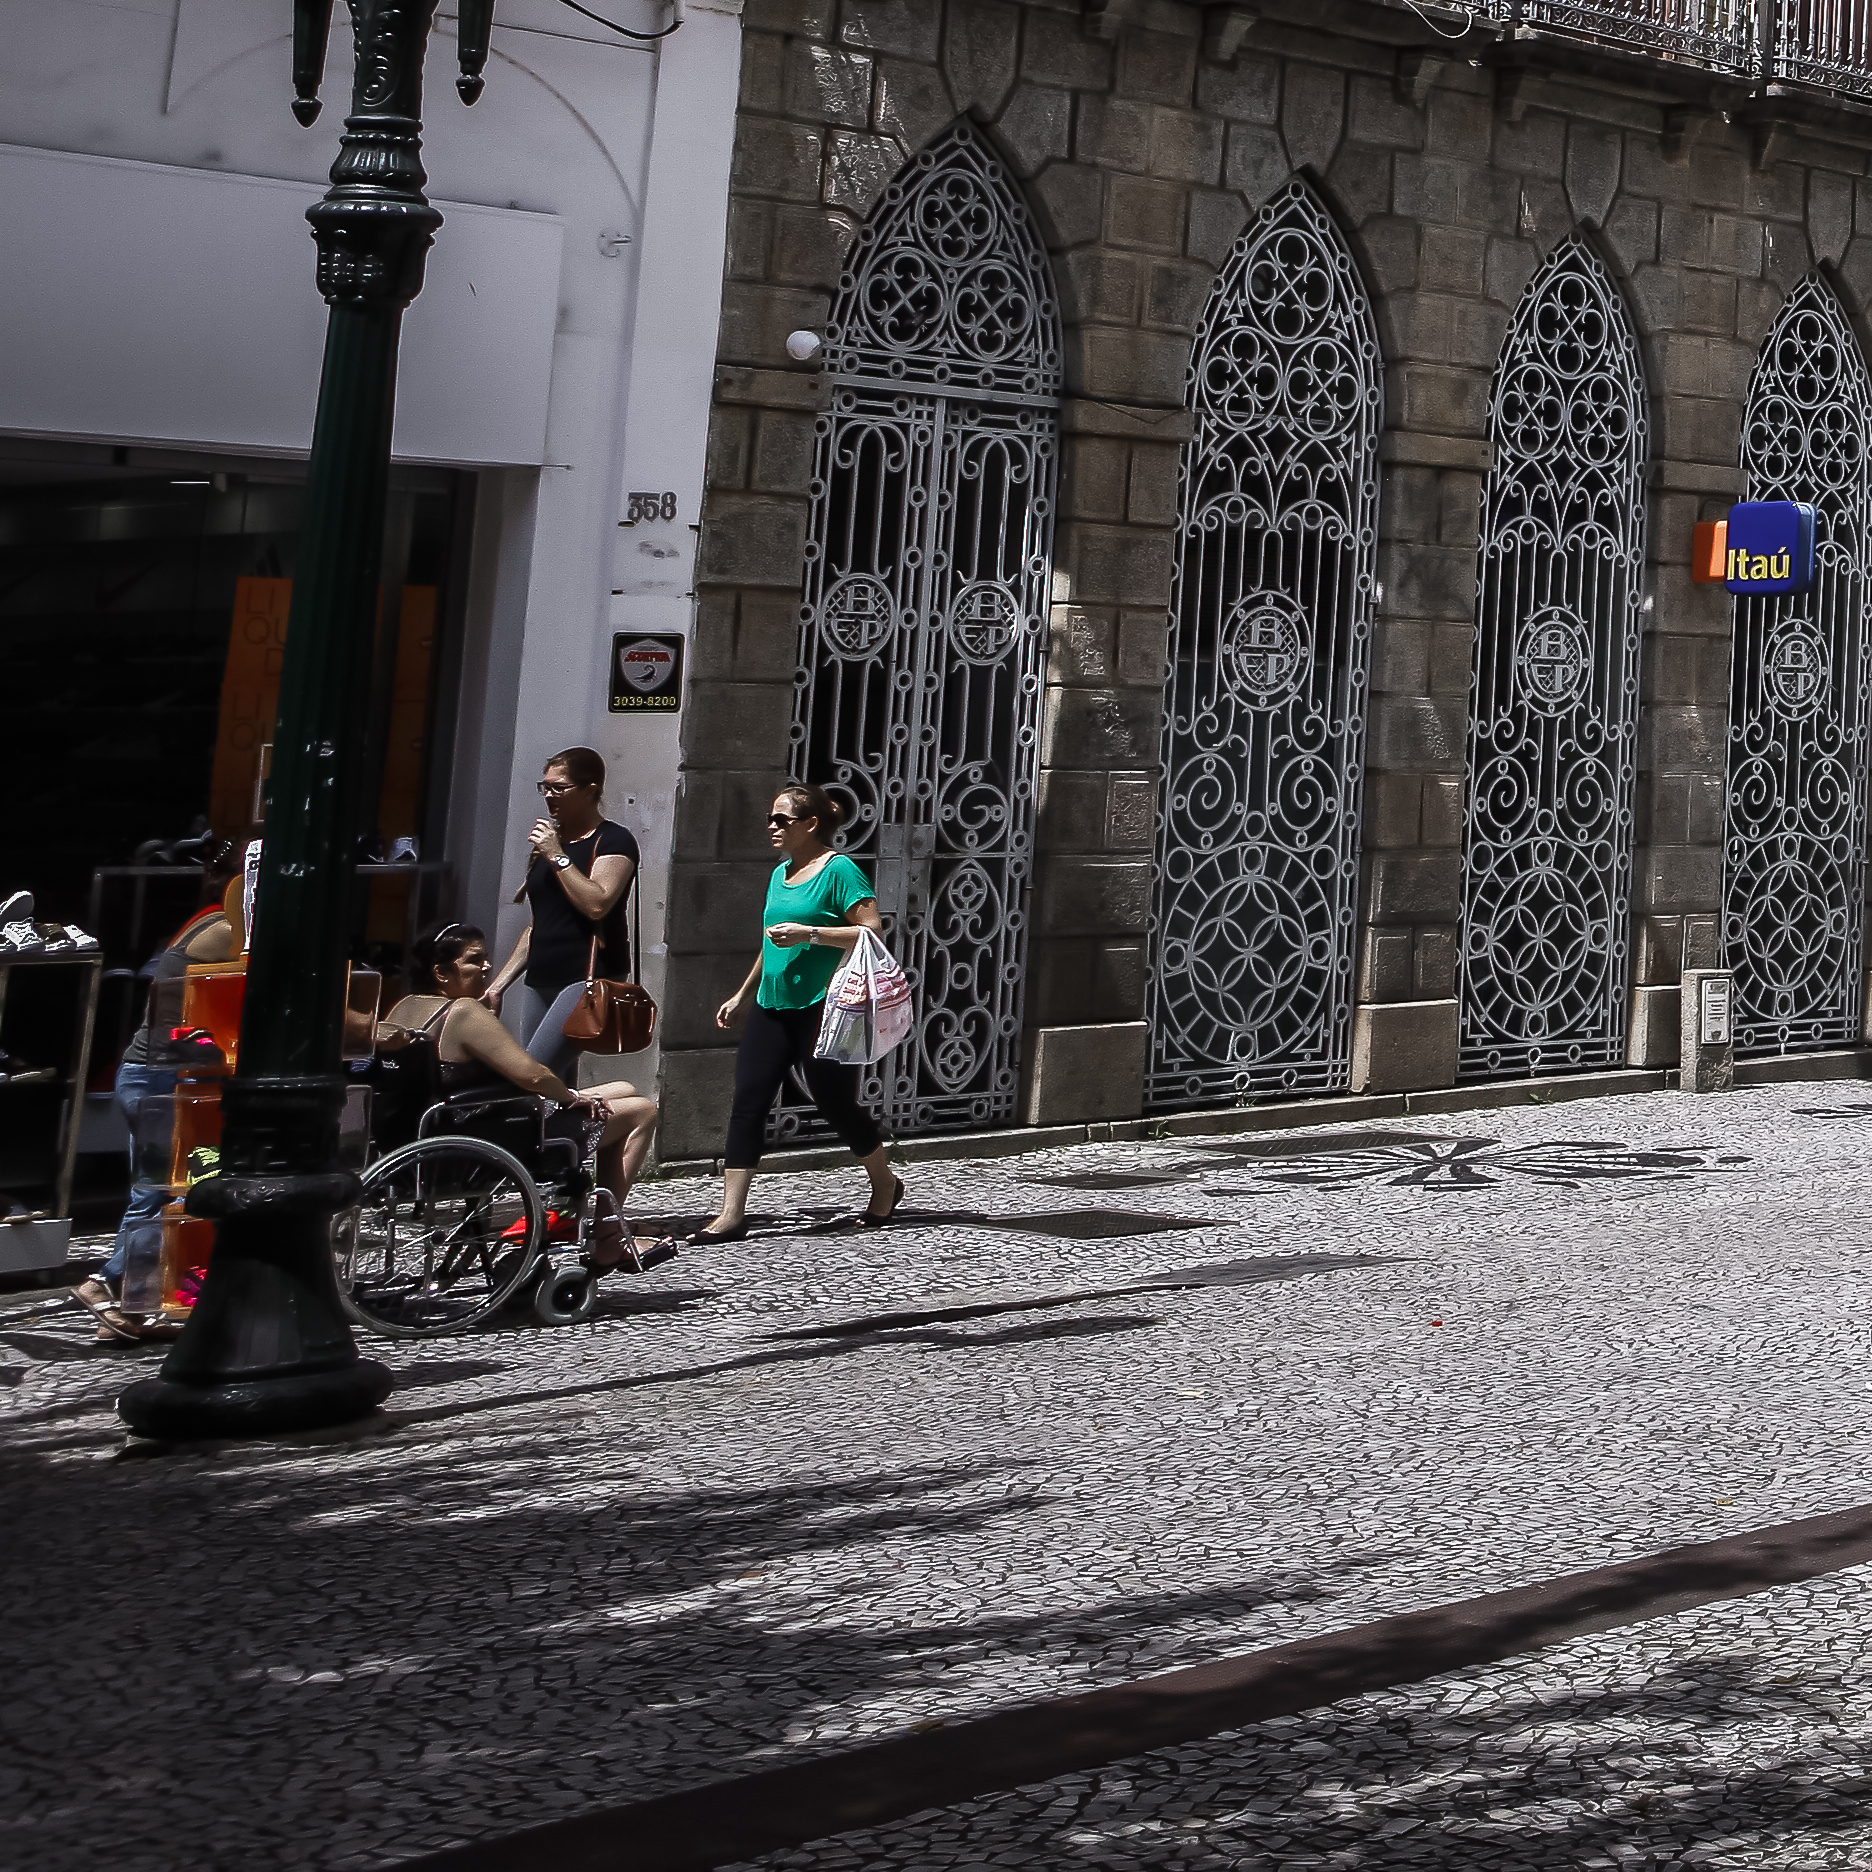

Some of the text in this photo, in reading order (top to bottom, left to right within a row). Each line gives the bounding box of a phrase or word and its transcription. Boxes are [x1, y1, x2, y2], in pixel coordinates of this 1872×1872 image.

[627, 491, 678, 523] 358
[1726, 546, 1790, 581] Itaú
[614, 696, 677, 707] 3039-8200
